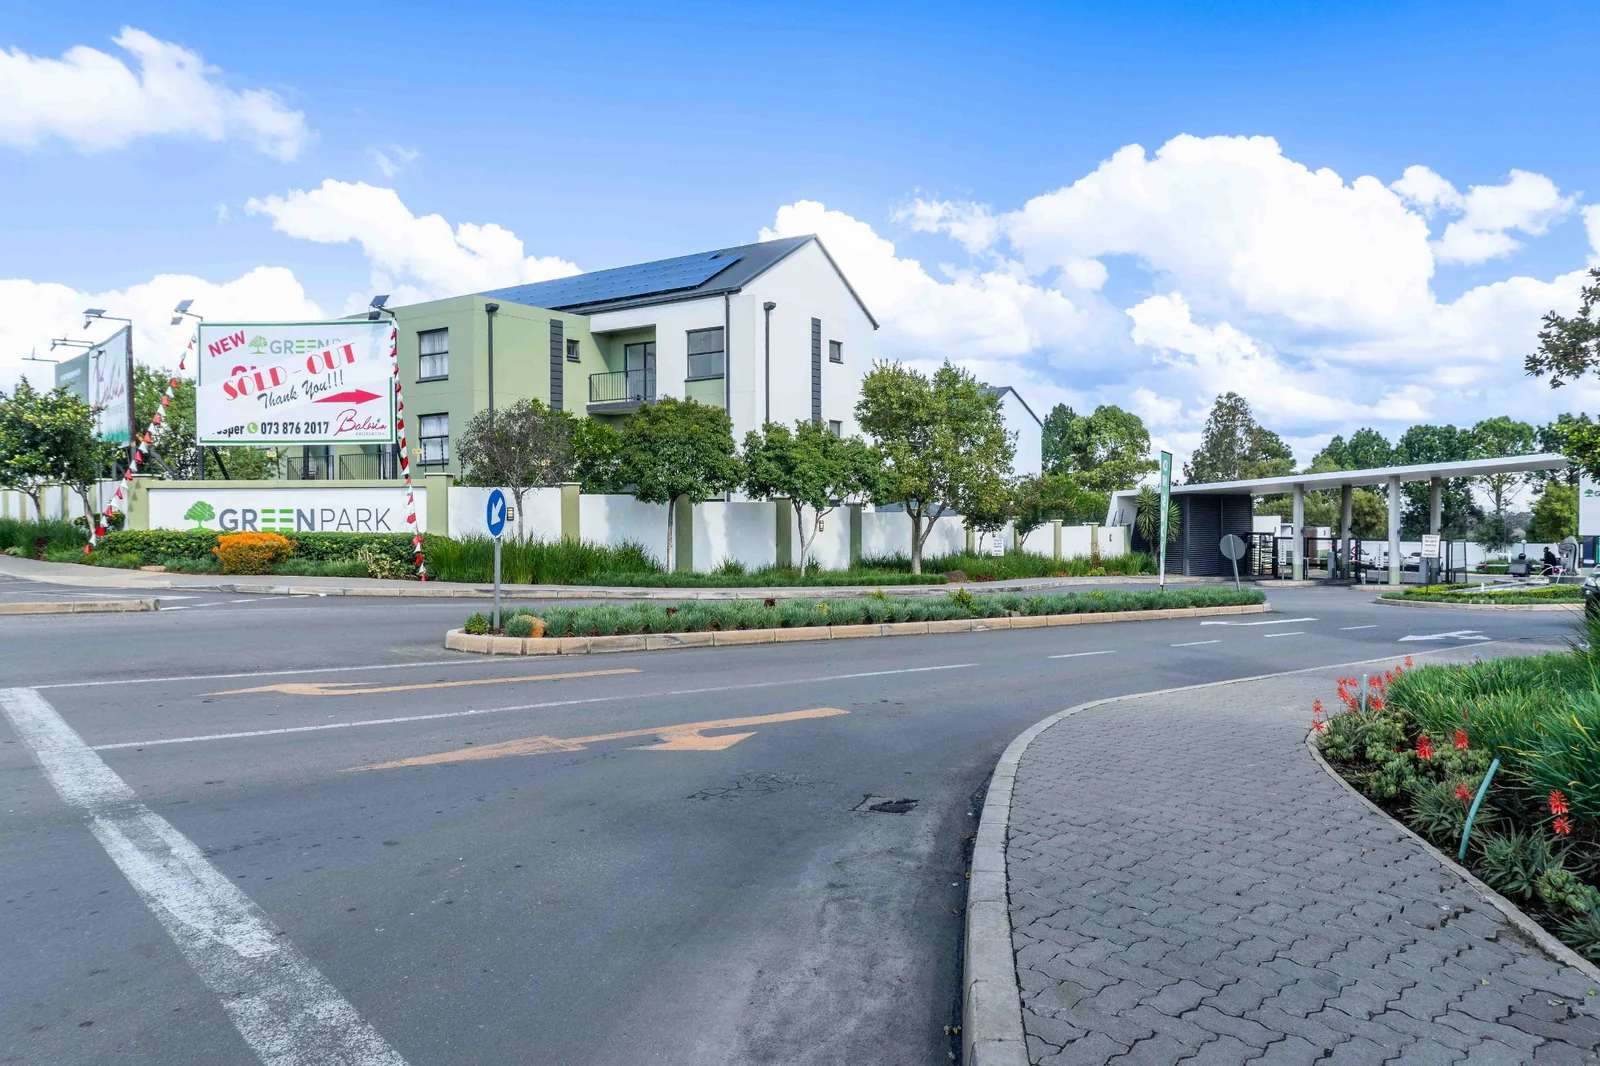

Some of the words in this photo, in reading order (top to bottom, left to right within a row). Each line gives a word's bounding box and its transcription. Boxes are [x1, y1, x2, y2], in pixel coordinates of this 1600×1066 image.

[207, 330, 246, 358] NEW
[257, 384, 299, 410] Thank
[301, 369, 344, 400] You!!!
[260, 421, 279, 435] 073
[282, 421, 301, 435] 876
[303, 421, 330, 435] 2017
